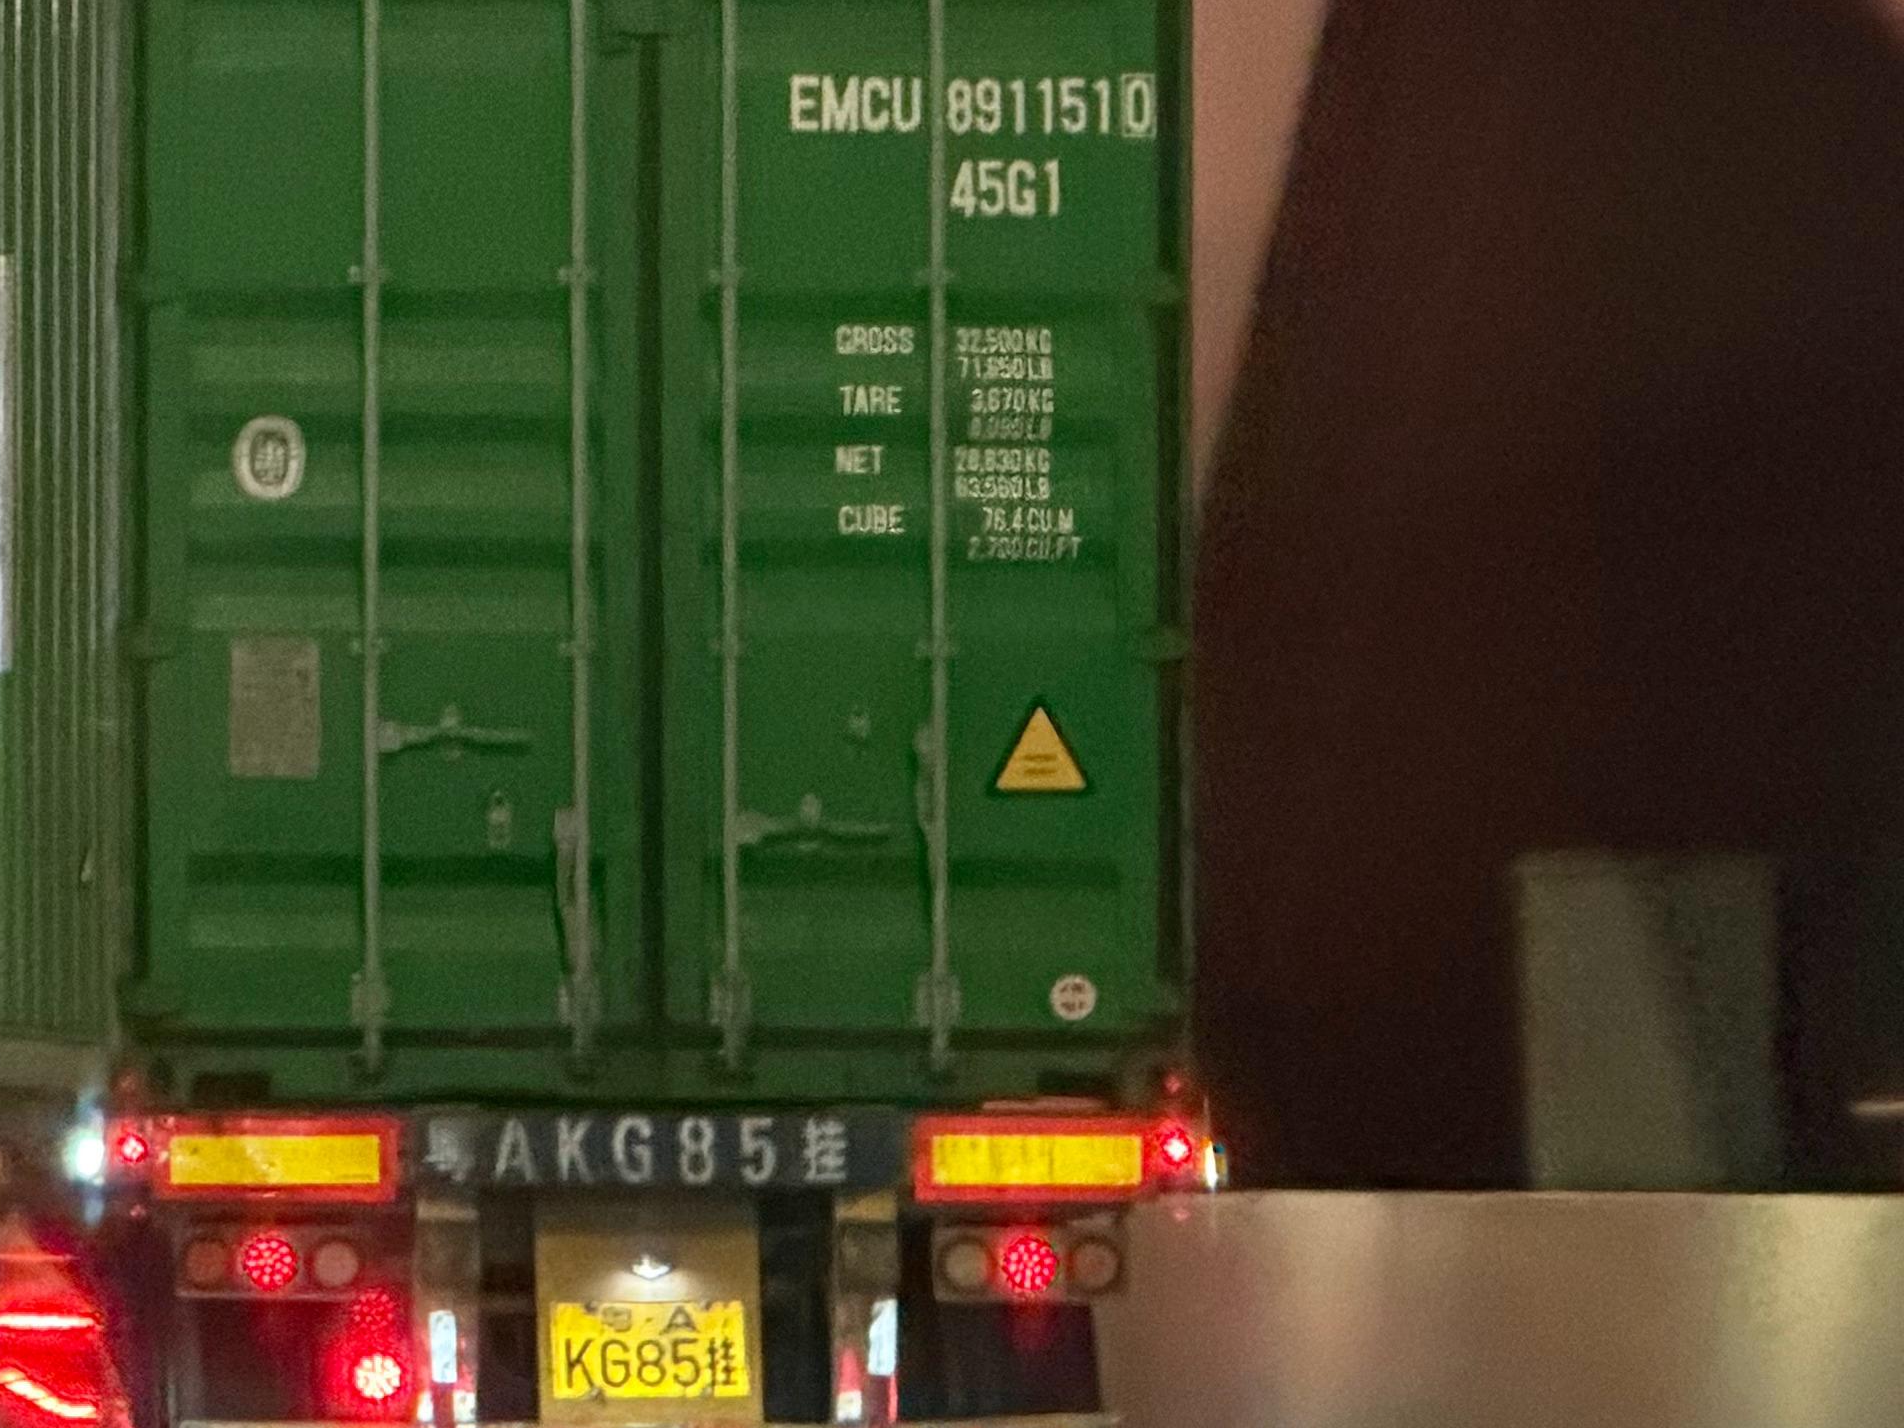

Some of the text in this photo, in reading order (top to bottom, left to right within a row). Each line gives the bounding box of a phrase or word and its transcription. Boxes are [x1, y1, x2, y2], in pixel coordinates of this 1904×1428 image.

[790, 75, 922, 133] EMCU
[950, 160, 1060, 217] 45G1
[836, 325, 914, 354] GROSS
[840, 385, 902, 415] TARE
[836, 445, 883, 474] NET
[839, 504, 905, 534] CUBE
